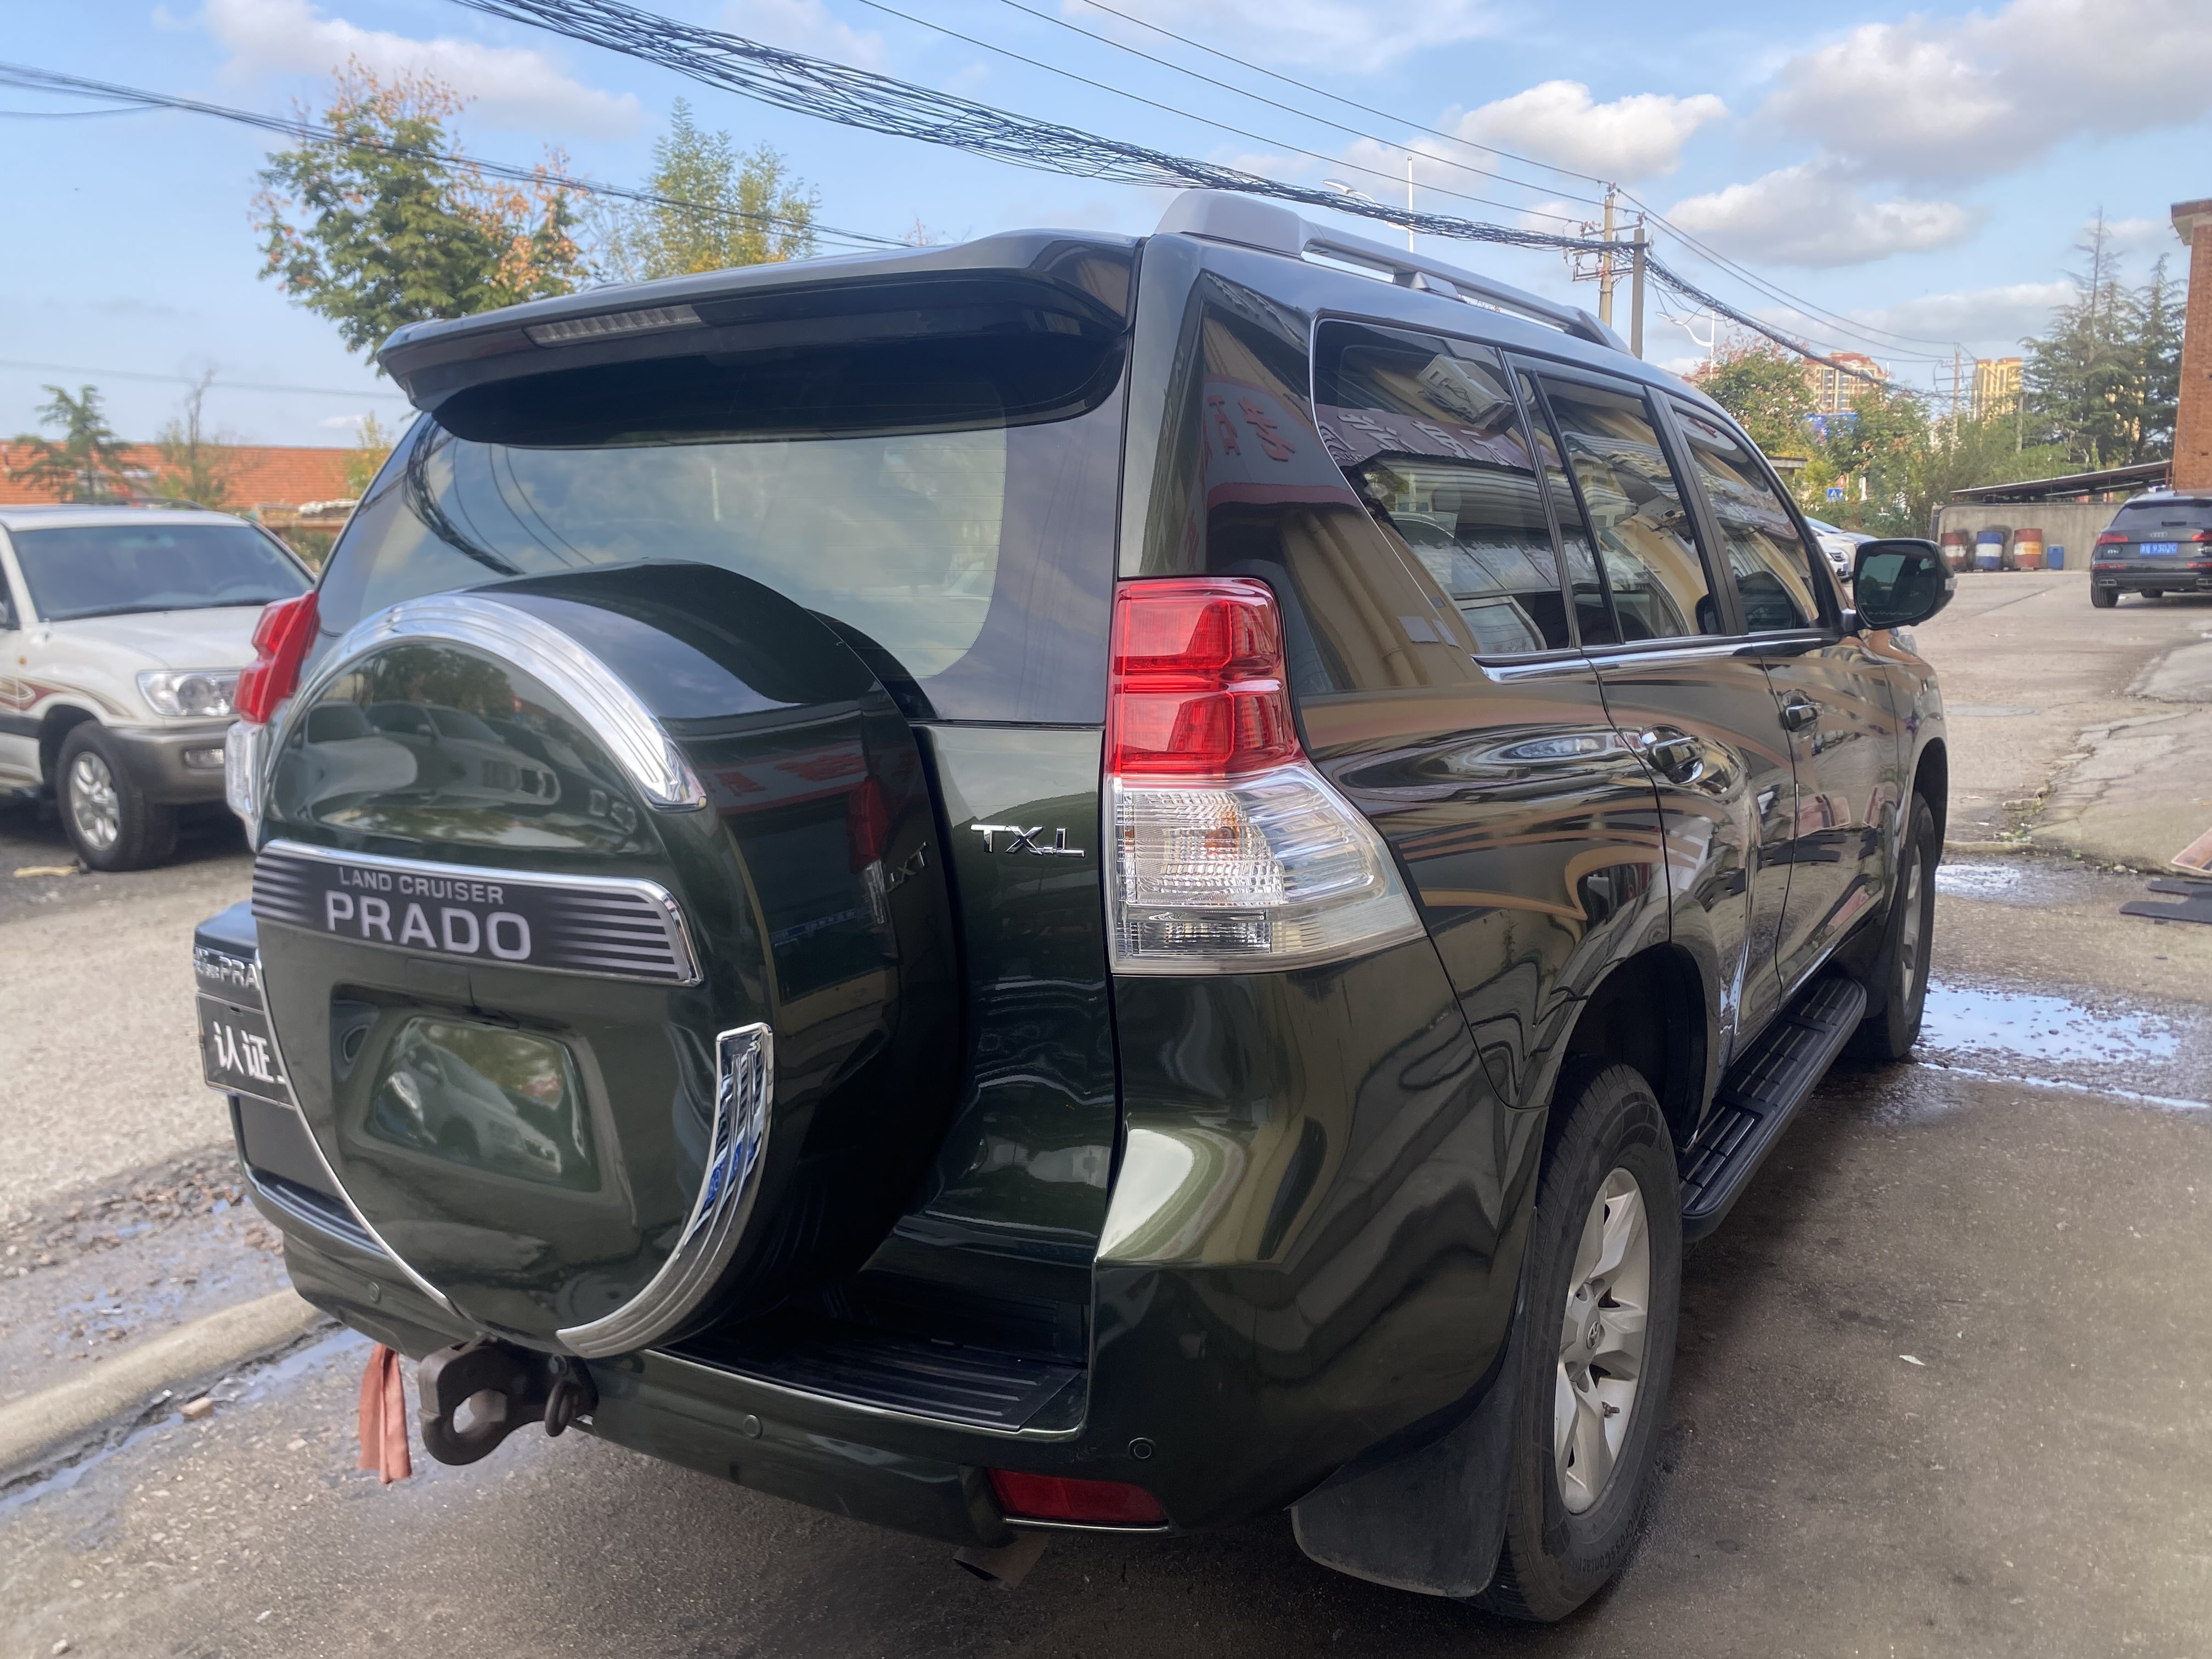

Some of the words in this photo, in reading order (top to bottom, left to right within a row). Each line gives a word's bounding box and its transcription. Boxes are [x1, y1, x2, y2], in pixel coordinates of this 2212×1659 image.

[970, 824, 1086, 858] TXL
[339, 866, 392, 892] LAND
[399, 876, 504, 905] CRUISER
[325, 889, 532, 961] PRADO
[213, 1020, 286, 1084] 认证
